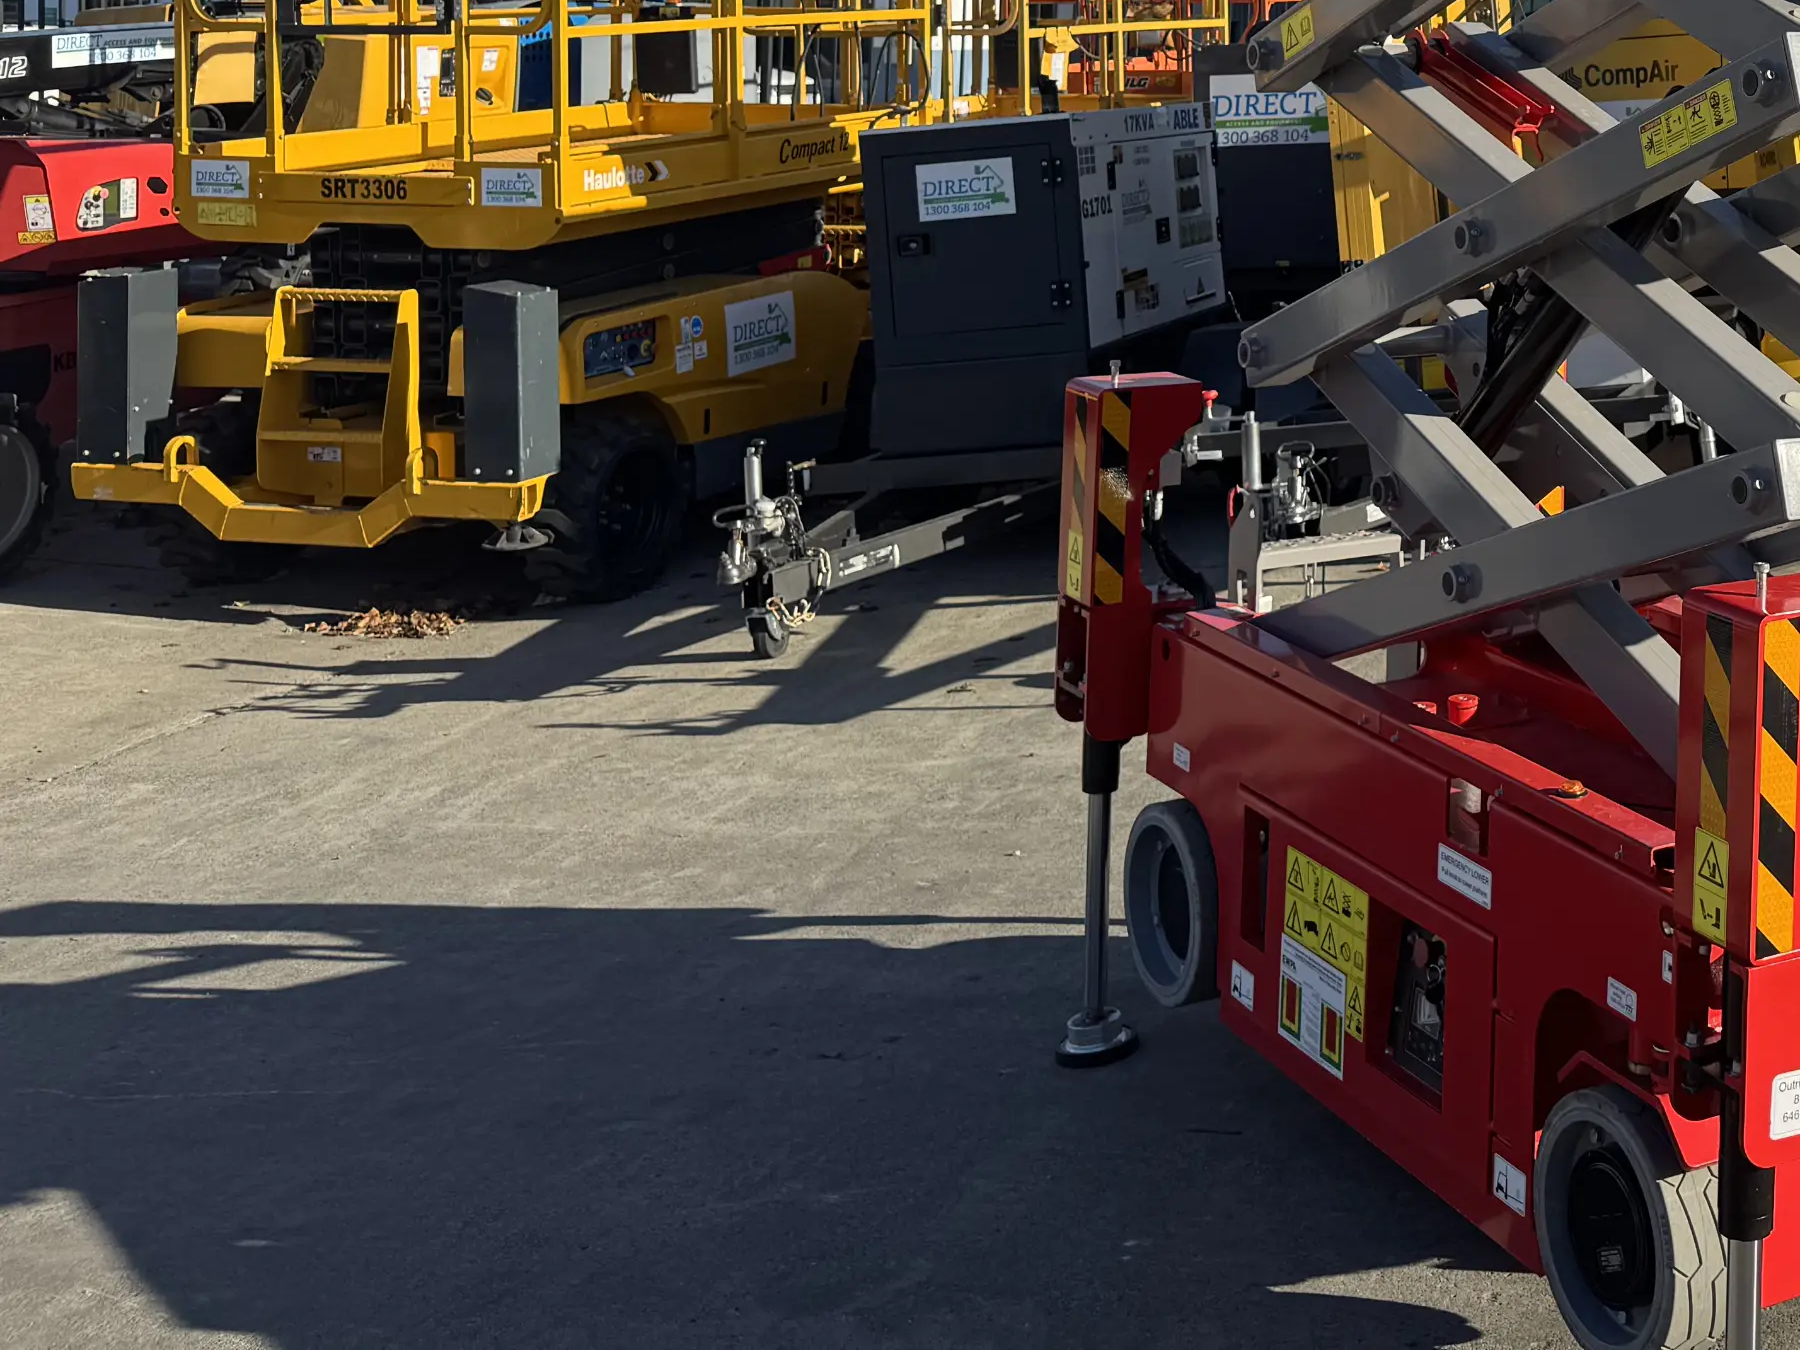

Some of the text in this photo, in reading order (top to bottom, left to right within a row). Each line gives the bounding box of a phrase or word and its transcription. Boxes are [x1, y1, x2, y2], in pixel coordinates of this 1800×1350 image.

[56, 34, 102, 50] DIRECT
[1584, 59, 1679, 88] CompAir
[1212, 92, 1317, 117] DIRECT
[1124, 113, 1154, 133] 17KVA
[1173, 108, 1199, 130] ABLE
[1218, 129, 1308, 144] 300 368 104
[779, 137, 835, 164] Compact
[196, 171, 238, 183] DIRECT
[321, 177, 407, 199] SRT3306
[486, 179, 527, 191] DIRECT
[583, 166, 644, 191] Haulotte
[922, 176, 995, 197] DIRECT
[925, 201, 991, 216] 1300 368 104
[1082, 194, 1113, 219] G1701
[733, 315, 782, 343] DIRECT
